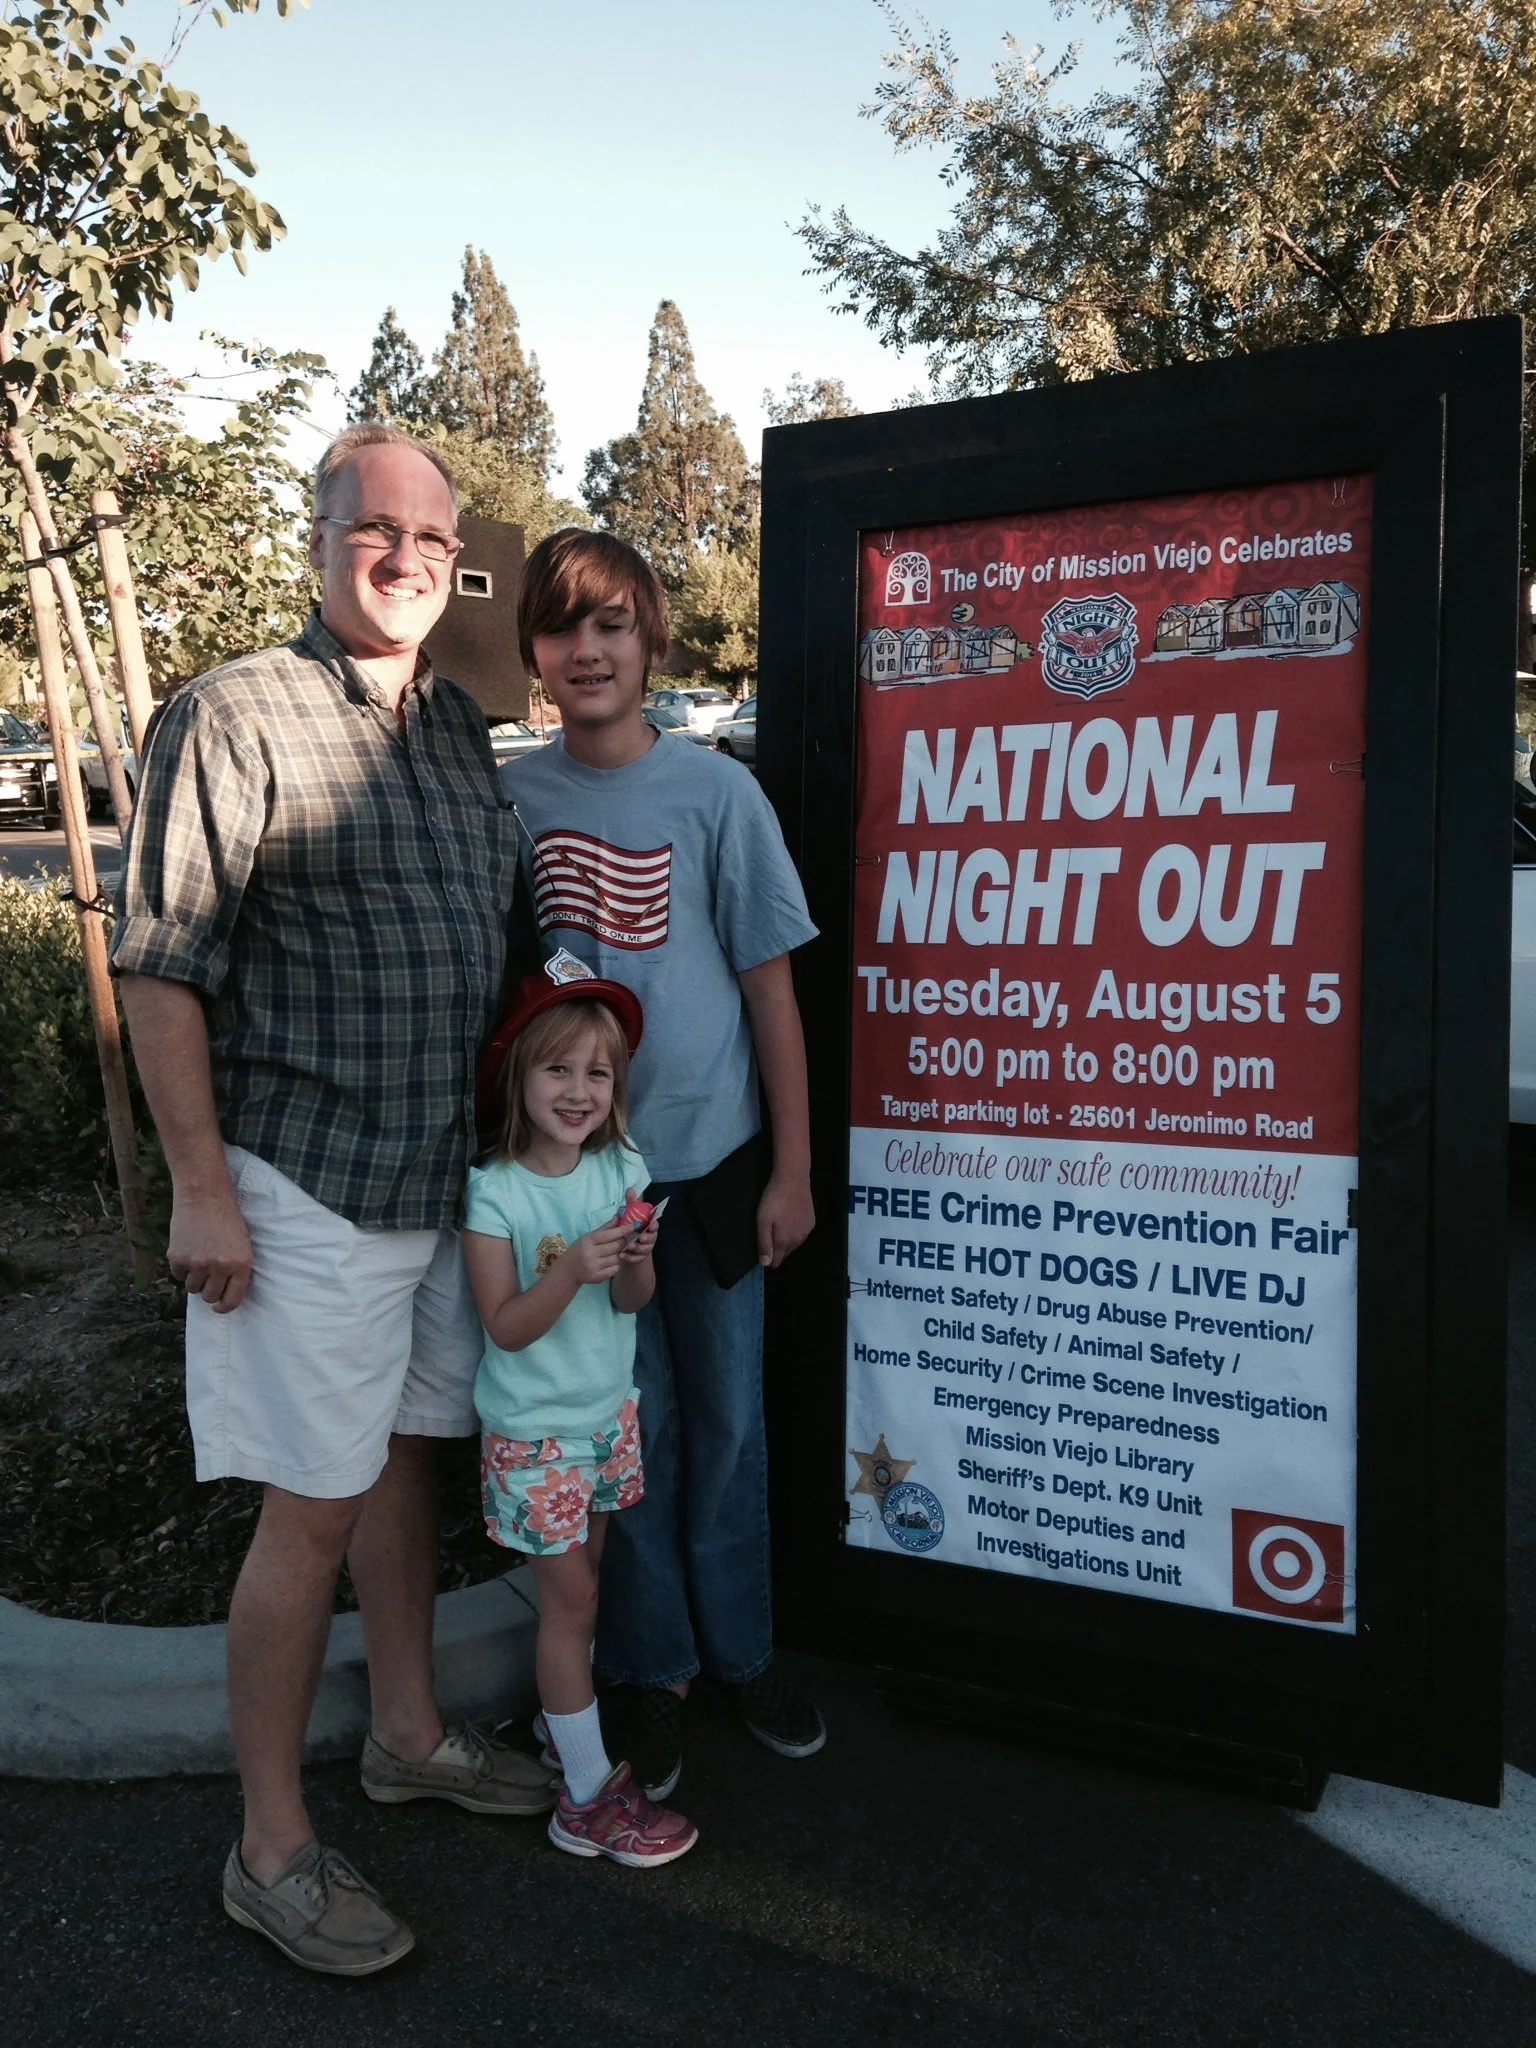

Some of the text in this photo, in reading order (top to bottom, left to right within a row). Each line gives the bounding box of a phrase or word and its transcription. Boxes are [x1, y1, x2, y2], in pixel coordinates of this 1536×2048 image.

[941, 530, 1352, 592] The City of Mission Viejo Celebrates
[1062, 612, 1117, 630] NIGHT
[1071, 604, 1106, 612] NATIONAL
[1067, 654, 1108, 668] OUT
[898, 710, 1295, 824] NATIONAL
[877, 842, 1326, 947] NIGHT OUT
[582, 916, 606, 933] TREAD
[610, 930, 624, 941] ON
[628, 934, 642, 942] ME
[858, 967, 1340, 1032] Tuesday, August 5
[909, 1037, 1274, 1096] 5:00 pm to 8:00 pm
[881, 1095, 938, 1122] Target
[945, 1100, 1016, 1127] parking
[1024, 1102, 1049, 1124] lot
[1070, 1105, 1134, 1129] 25601
[1145, 1108, 1247, 1135] Jeronimo
[1256, 1114, 1313, 1139] Road
[885, 1138, 1301, 1208] Celebrate our safe community!
[849, 1185, 1349, 1255] FREE Crime Prevention Fair
[879, 1238, 954, 1271] FREE
[966, 1246, 1031, 1278] HOT
[1041, 1253, 1138, 1289] DOGS
[1172, 1265, 1246, 1300] LIVE
[1259, 1273, 1305, 1307] DJ
[867, 1278, 944, 1304] Internet
[951, 1287, 1018, 1316] Safety
[1037, 1296, 1089, 1324] Drug
[1097, 1302, 1166, 1328] Abuse
[924, 1318, 974, 1341] Child
[982, 1324, 1047, 1355] Safety
[1068, 1335, 1142, 1361] Animal
[1150, 1343, 1225, 1376] Safety
[854, 1342, 910, 1367] Home
[917, 1350, 1002, 1383] Security
[1021, 1364, 1085, 1390] Crime
[1093, 1372, 1164, 1400] Scene
[1173, 1382, 1327, 1422] Investigation
[934, 1387, 1219, 1446] Emergency Preparedness
[966, 1426, 1194, 1482] Mission Viejo Library
[889, 1487, 917, 1506] MISSION
[958, 1459, 1202, 1516] Sheriff's Dept. K9 Unit
[968, 1495, 1185, 1549] Motor Deputies and
[978, 1532, 1181, 1586] Investigations Unit
